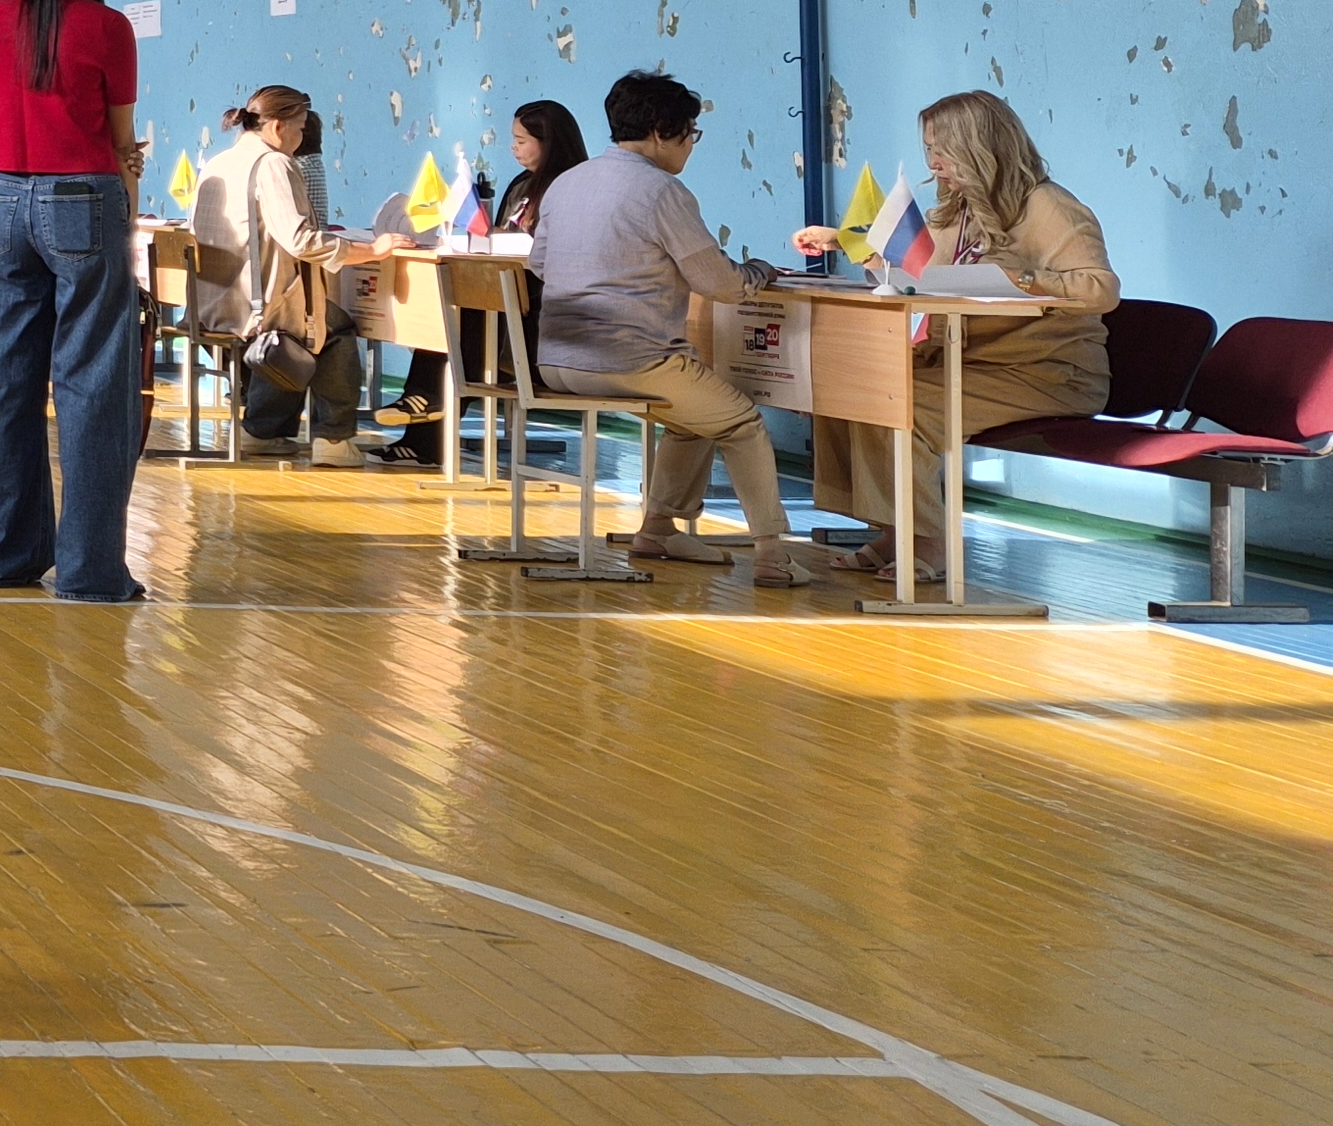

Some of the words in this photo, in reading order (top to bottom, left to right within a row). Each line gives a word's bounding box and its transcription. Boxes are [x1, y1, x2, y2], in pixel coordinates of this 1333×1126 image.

[745, 339, 755, 351] 18
[755, 333, 765, 345] 19
[766, 328, 779, 341] 20
